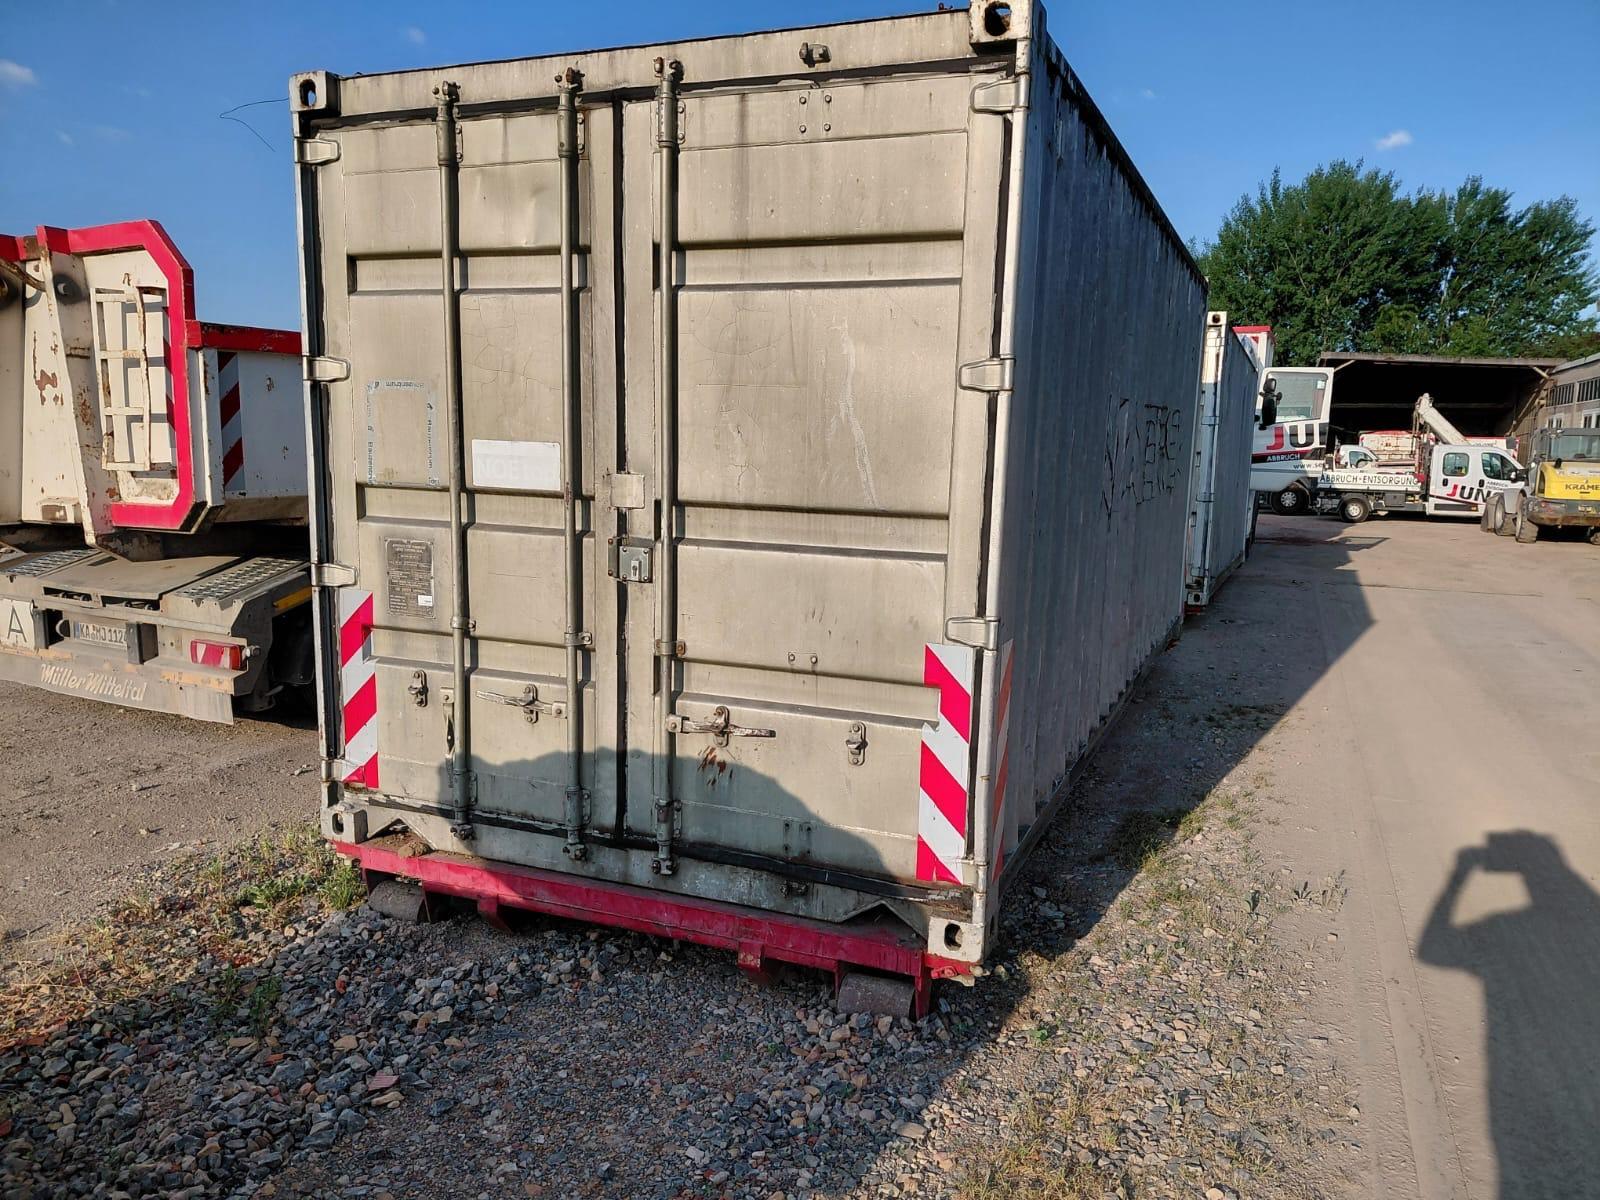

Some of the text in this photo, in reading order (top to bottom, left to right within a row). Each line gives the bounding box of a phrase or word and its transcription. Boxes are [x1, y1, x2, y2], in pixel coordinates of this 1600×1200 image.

[1266, 453, 1300, 462] ABBRUCH
[6, 605, 28, 643] A
[80, 624, 90, 639] KA
[40, 663, 86, 689] Müller
